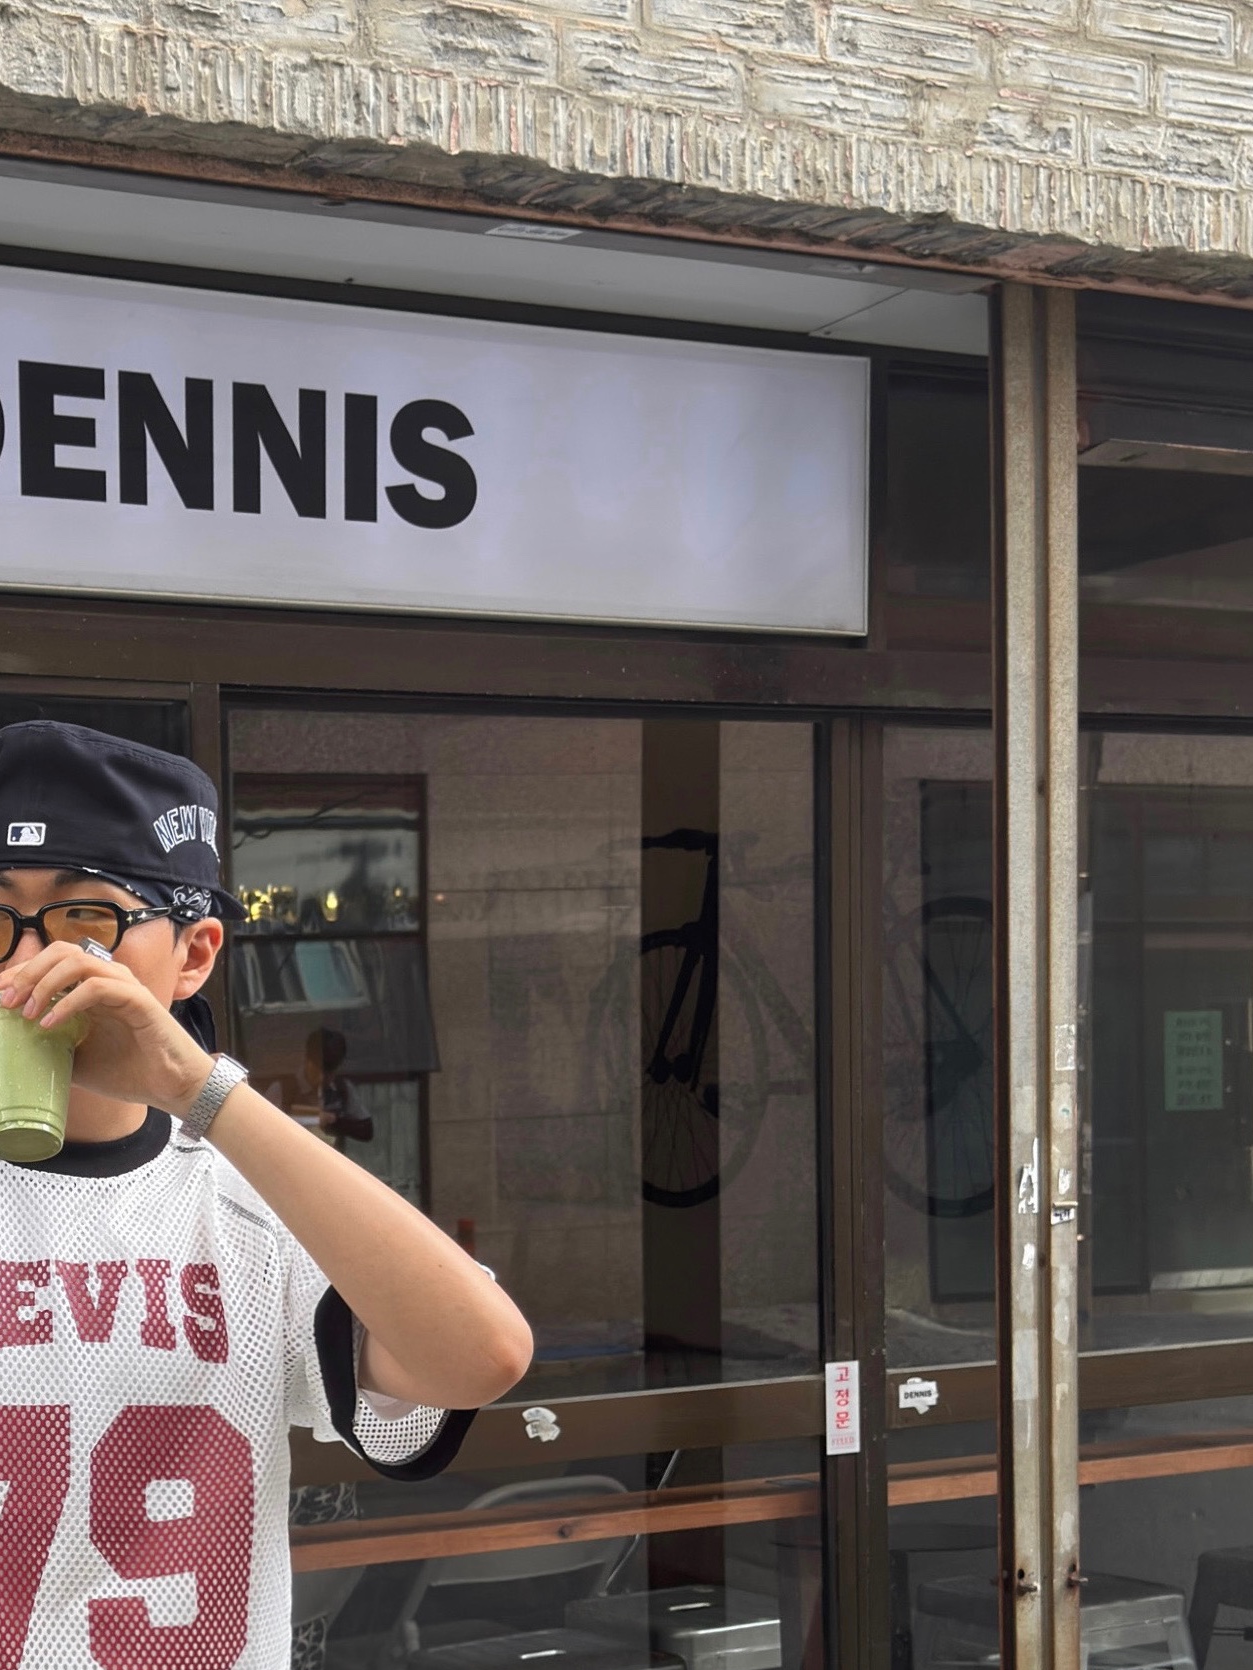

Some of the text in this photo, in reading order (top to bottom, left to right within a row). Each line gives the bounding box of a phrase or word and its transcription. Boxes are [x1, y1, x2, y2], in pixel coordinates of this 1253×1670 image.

[153, 805, 221, 863] NEW YO
[834, 1366, 851, 1430] 고정문
[903, 1390, 932, 1399] DENNIS
